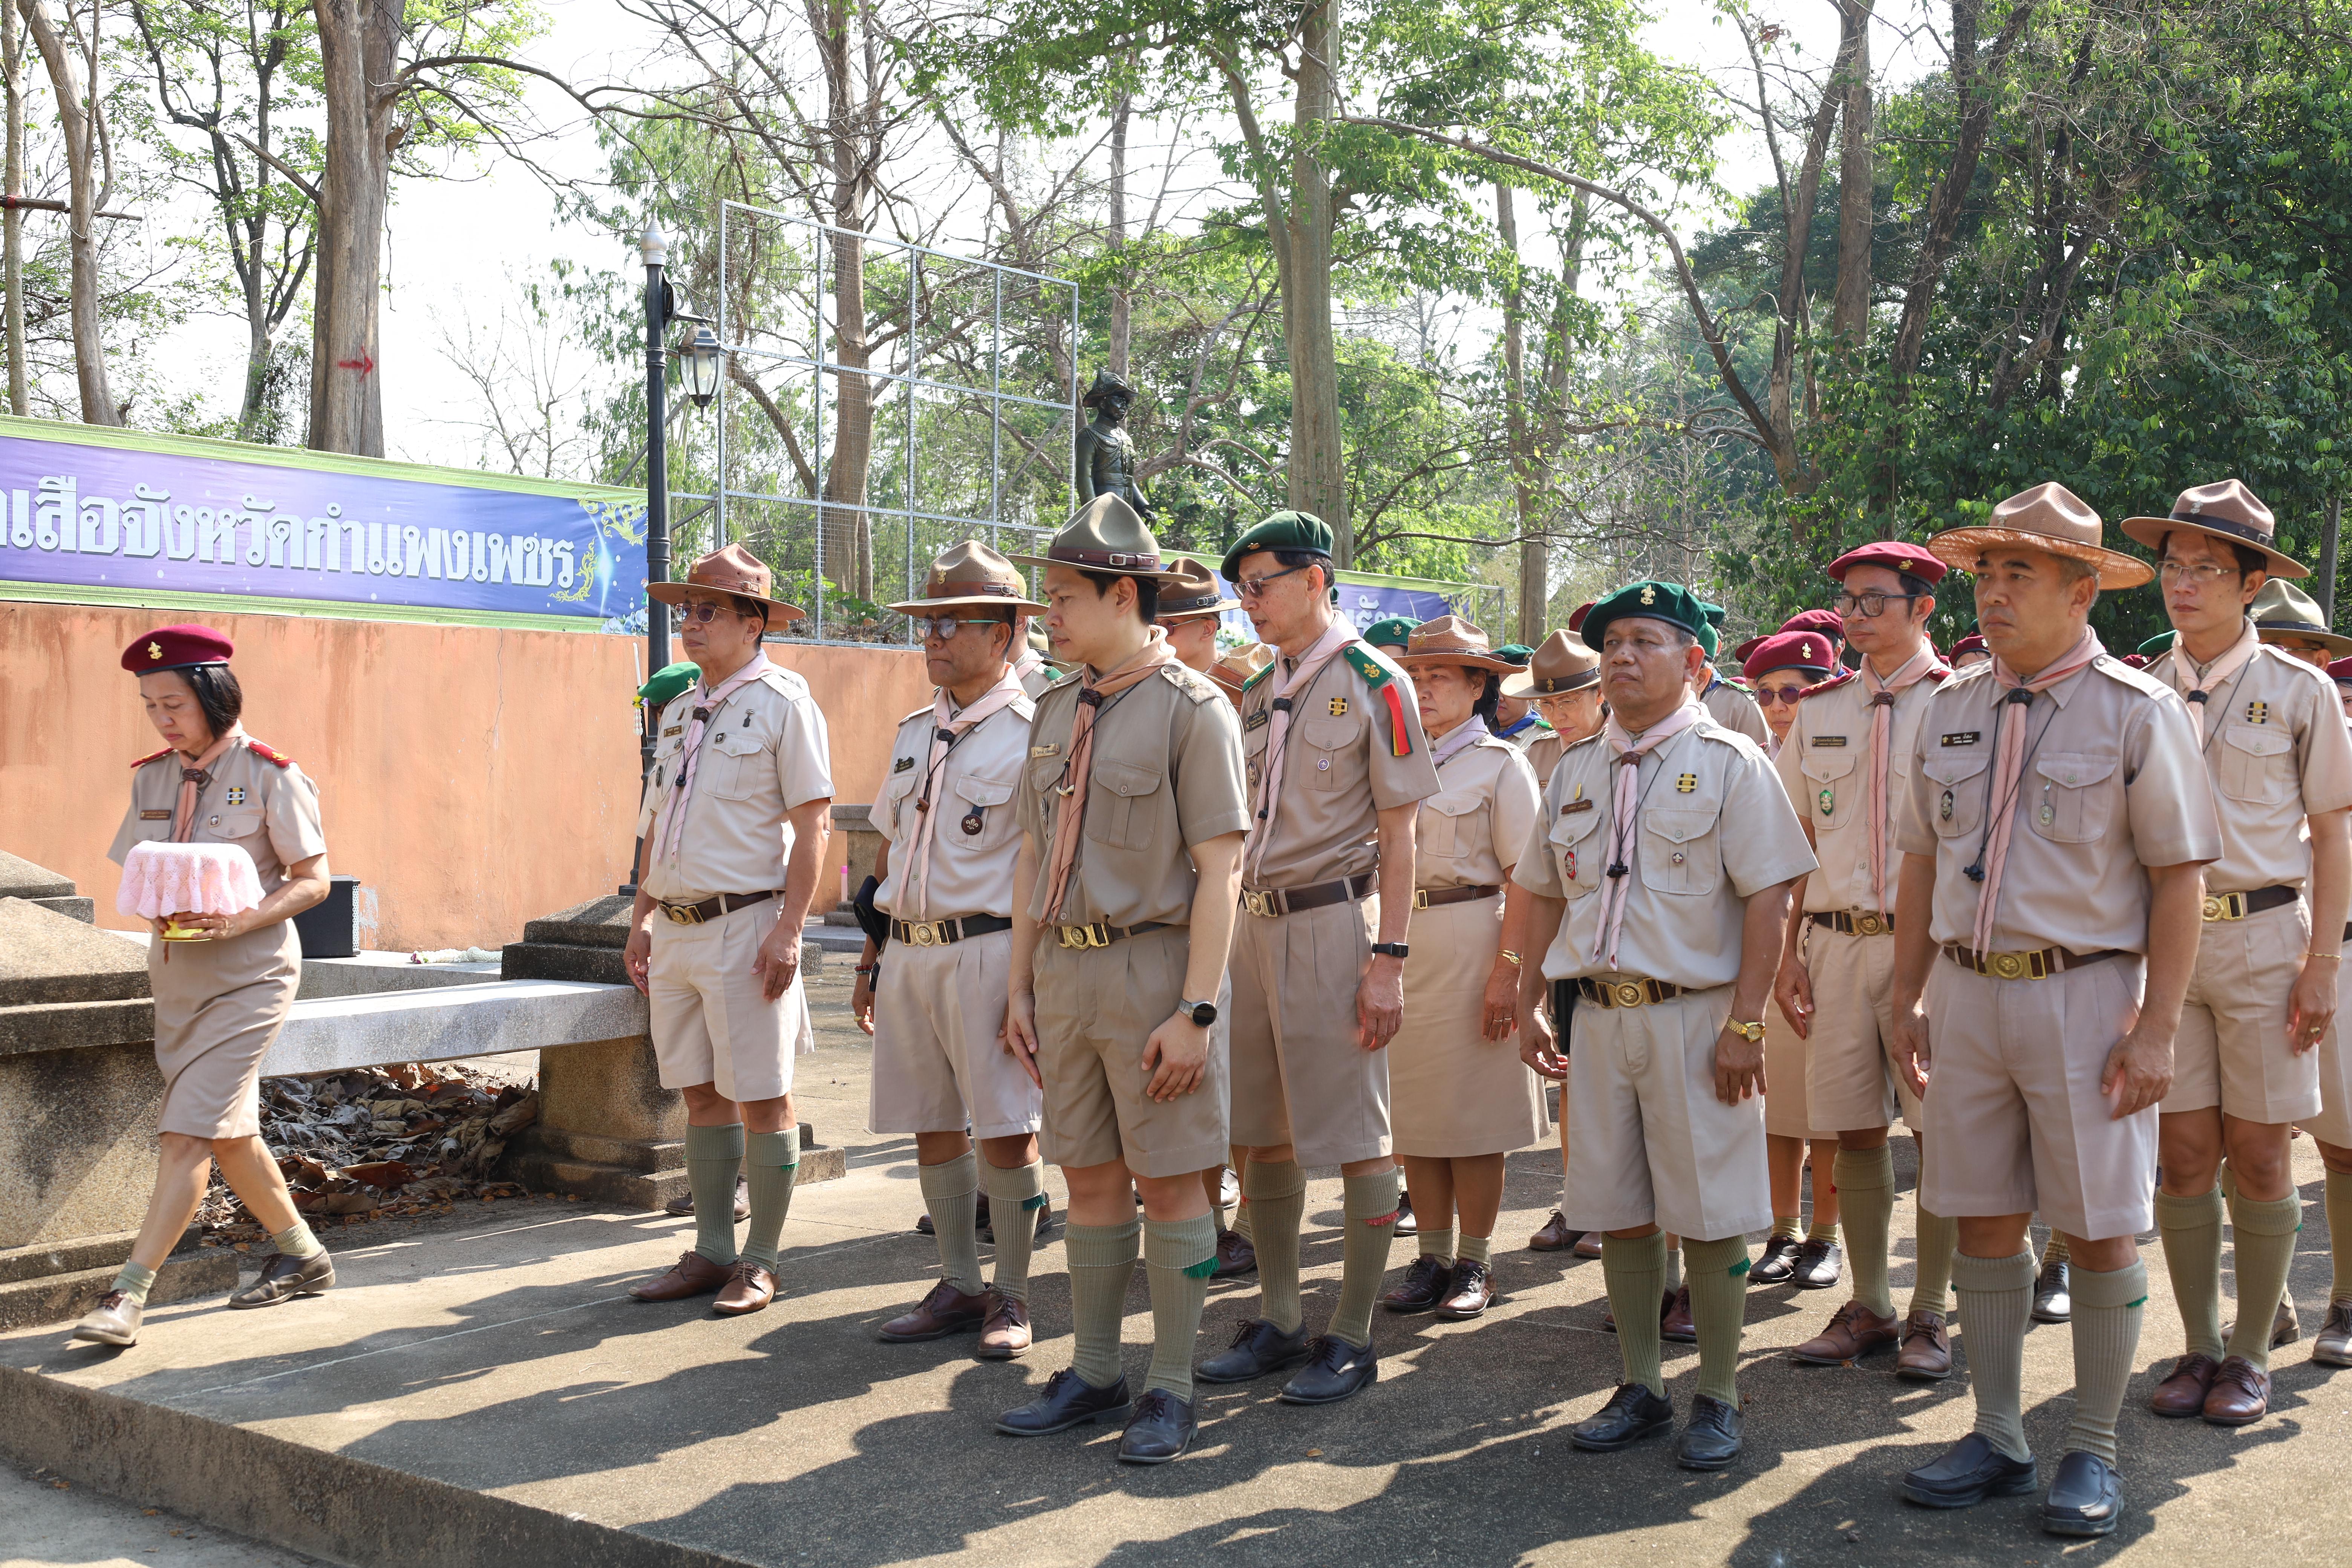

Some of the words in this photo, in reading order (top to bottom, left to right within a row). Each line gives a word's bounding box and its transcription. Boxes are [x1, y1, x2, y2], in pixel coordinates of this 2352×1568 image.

[0, 475, 574, 588] เสือจังหวัดกำแพงเพชร
